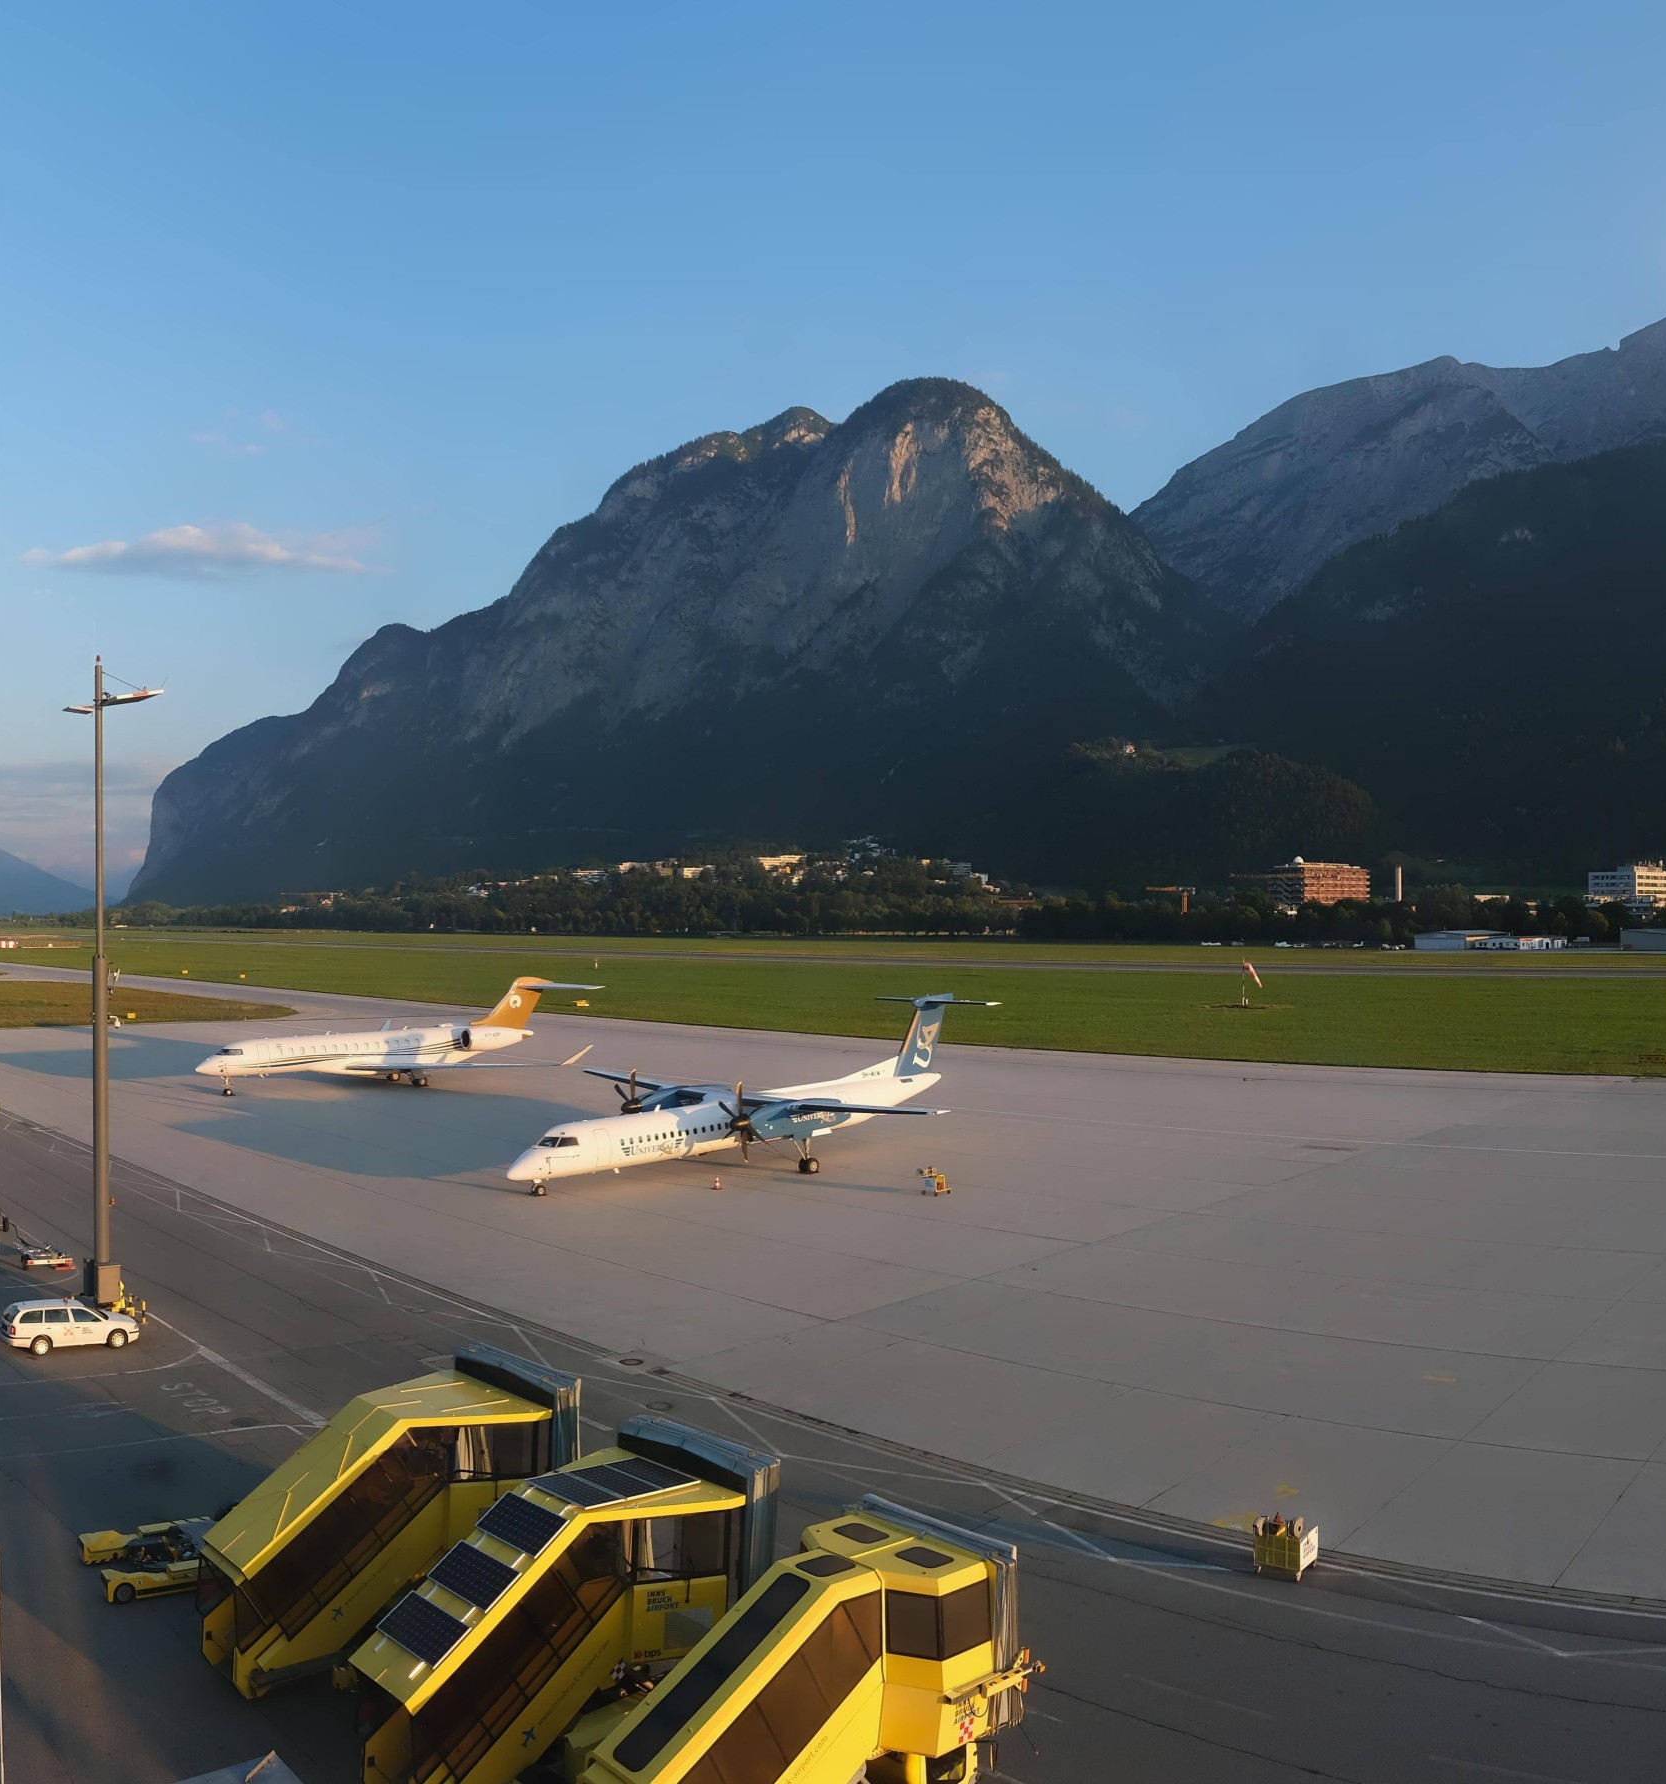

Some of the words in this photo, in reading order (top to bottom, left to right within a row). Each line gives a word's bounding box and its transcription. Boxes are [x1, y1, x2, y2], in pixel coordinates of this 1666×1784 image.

[160, 1382, 231, 1415] STOP
[647, 1589, 667, 1597] INNS
[646, 1596, 672, 1605] BRUCK
[646, 1602, 680, 1612] AIRPORT
[537, 1639, 611, 1726] www.innsbruck-airport.com
